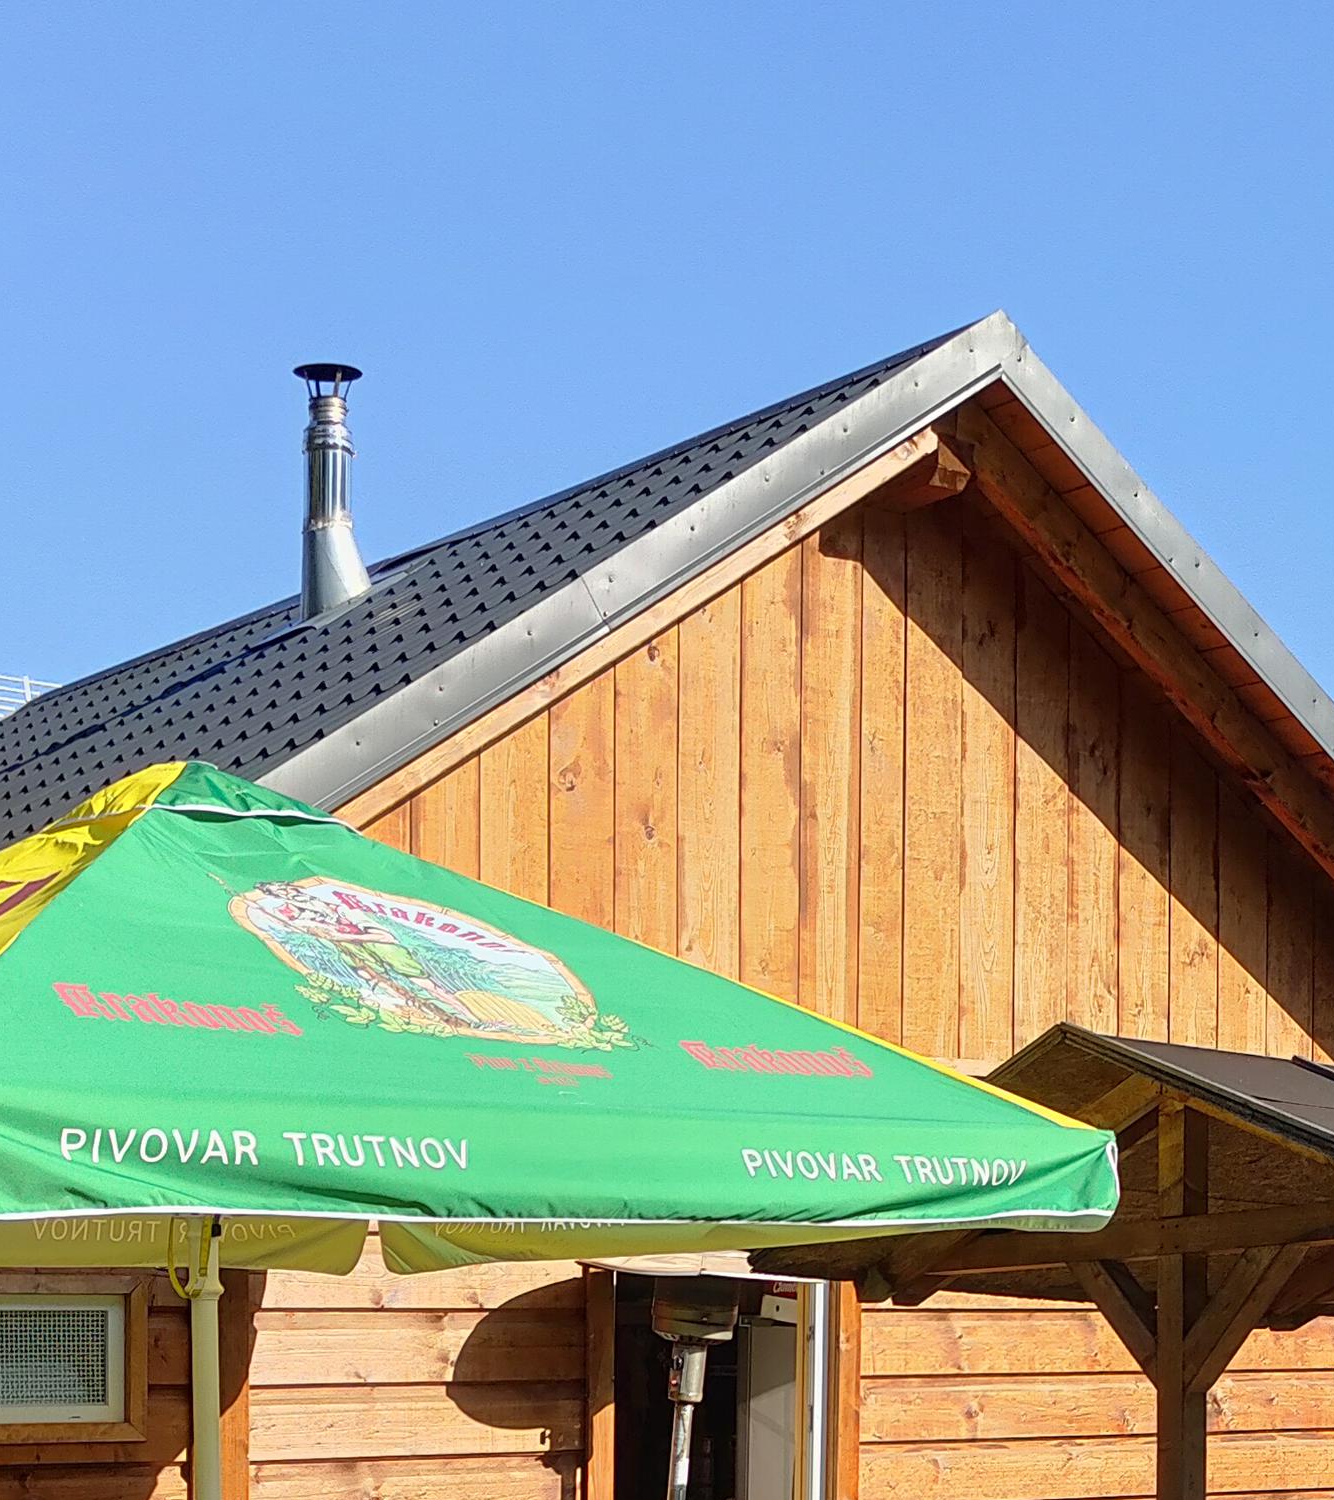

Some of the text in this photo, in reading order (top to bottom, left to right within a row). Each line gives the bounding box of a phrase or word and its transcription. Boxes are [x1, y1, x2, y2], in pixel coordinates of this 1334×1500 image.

[60, 1127, 468, 1170] PIVOVAR TRUTNOV
[740, 1148, 1028, 1186] PIVOVAR TRUTNOV
